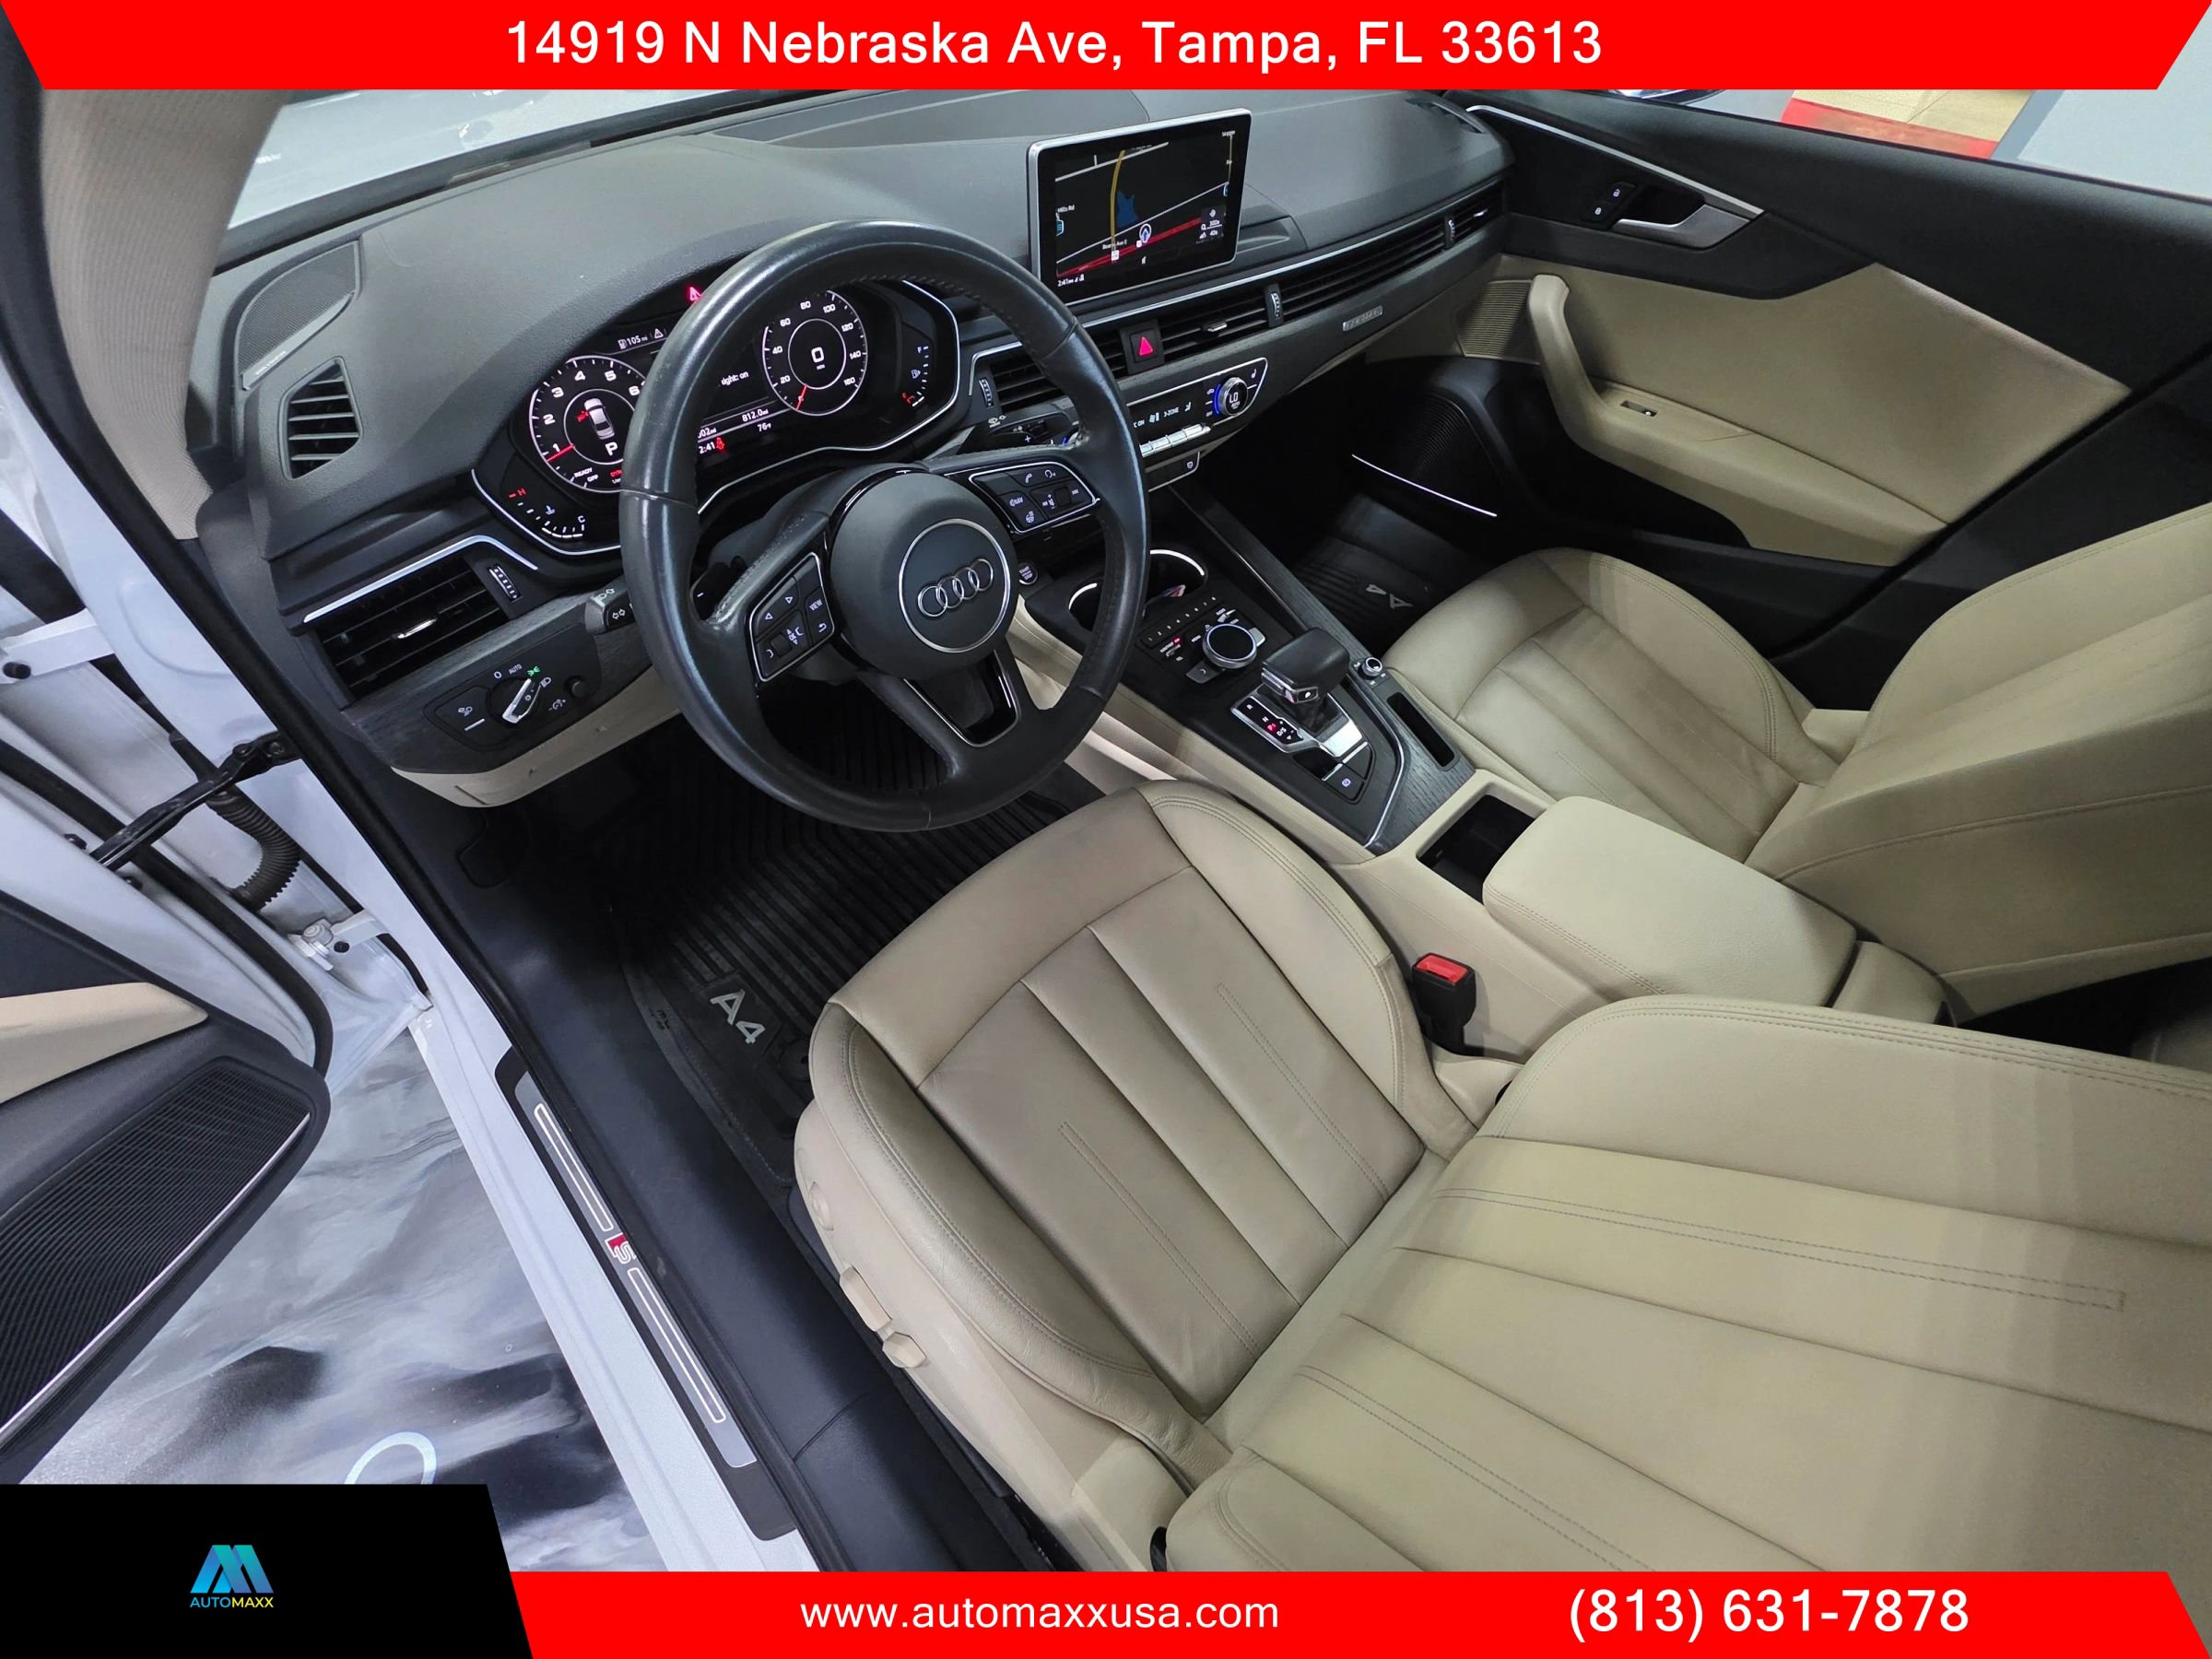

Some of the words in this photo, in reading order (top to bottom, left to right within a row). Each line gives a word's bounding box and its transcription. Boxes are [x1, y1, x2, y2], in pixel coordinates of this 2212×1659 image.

[800, 300, 812, 311] 80
[822, 303, 836, 313] 100
[841, 323, 853, 332] 120
[627, 335, 641, 346] 105
[771, 345, 783, 355] 40
[810, 346, 825, 363] 0
[849, 350, 862, 360] 140
[574, 370, 586, 382] 4
[604, 370, 617, 382] 5
[739, 371, 749, 380] on
[780, 374, 791, 384] 20
[551, 387, 564, 398] 3
[628, 385, 641, 396] 6
[543, 413, 556, 425] 2
[552, 442, 560, 453] 1
[605, 441, 618, 456] P
[577, 515, 585, 524] C
[808, 599, 823, 612] VIEW
[508, 664, 523, 676] AUTO
[710, 988, 766, 1044] A4
